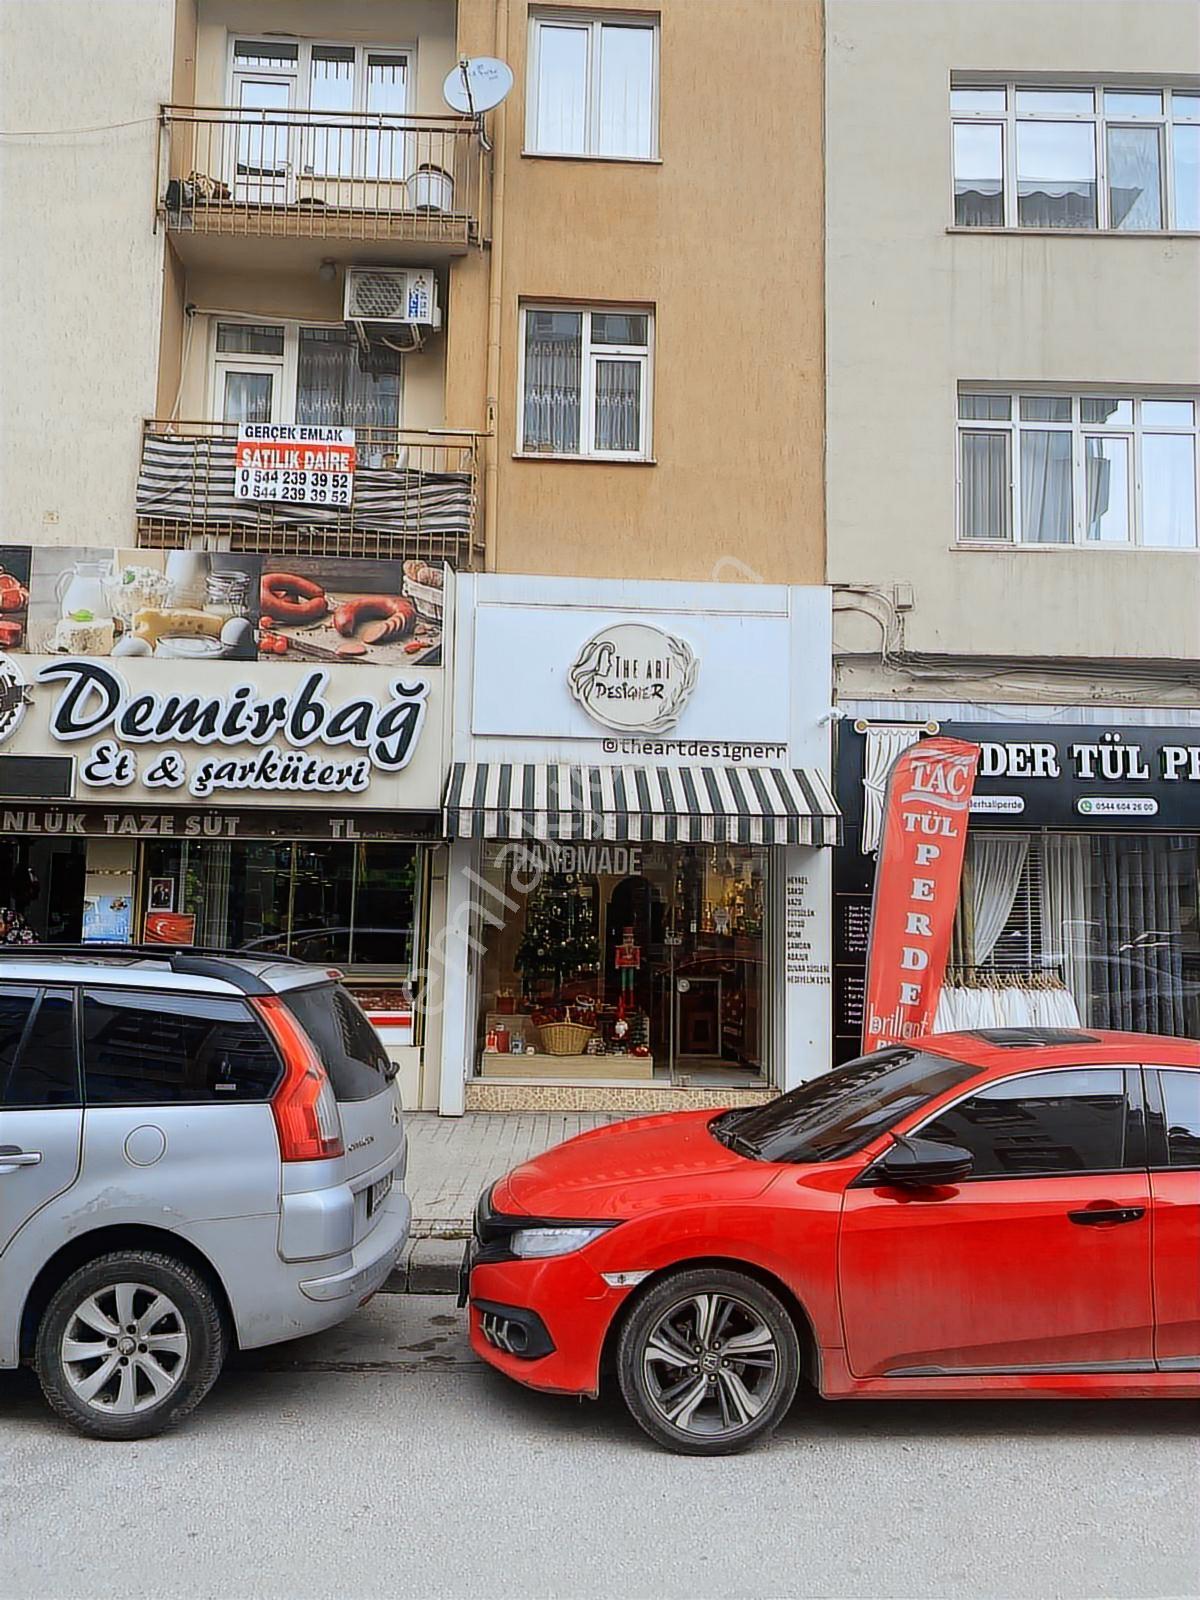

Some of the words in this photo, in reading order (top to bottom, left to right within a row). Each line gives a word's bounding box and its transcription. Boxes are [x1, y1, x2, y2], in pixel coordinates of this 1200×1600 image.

[245, 425, 296, 441] GERÇEK
[300, 427, 342, 441] EMLAK
[242, 447, 300, 469] SATILIK
[241, 469, 249, 482] 0
[254, 470, 278, 483] 544
[282, 471, 307, 485] 239
[311, 473, 328, 487] 39
[331, 474, 348, 488] 52
[240, 484, 248, 496] 0
[253, 486, 277, 498] 544
[281, 487, 306, 500] 239
[310, 489, 327, 501] 39
[331, 490, 347, 503] 52
[616, 656, 638, 678] THE
[646, 657, 671, 679] ART
[37, 660, 427, 765] Demirbağ
[84, 744, 129, 781] Et
[147, 757, 181, 782] &
[194, 749, 367, 791] şarküteri
[975, 742, 1060, 777] DER
[1072, 732, 1149, 779] TÜL
[2, 807, 86, 833] NLÜK
[104, 814, 175, 835] TAZE
[184, 810, 240, 836] SÜT
[328, 819, 360, 838] TL
[903, 810, 958, 837] TÜL
[512, 843, 643, 876] HANDMADE
[897, 843, 941, 1006] PERDE
